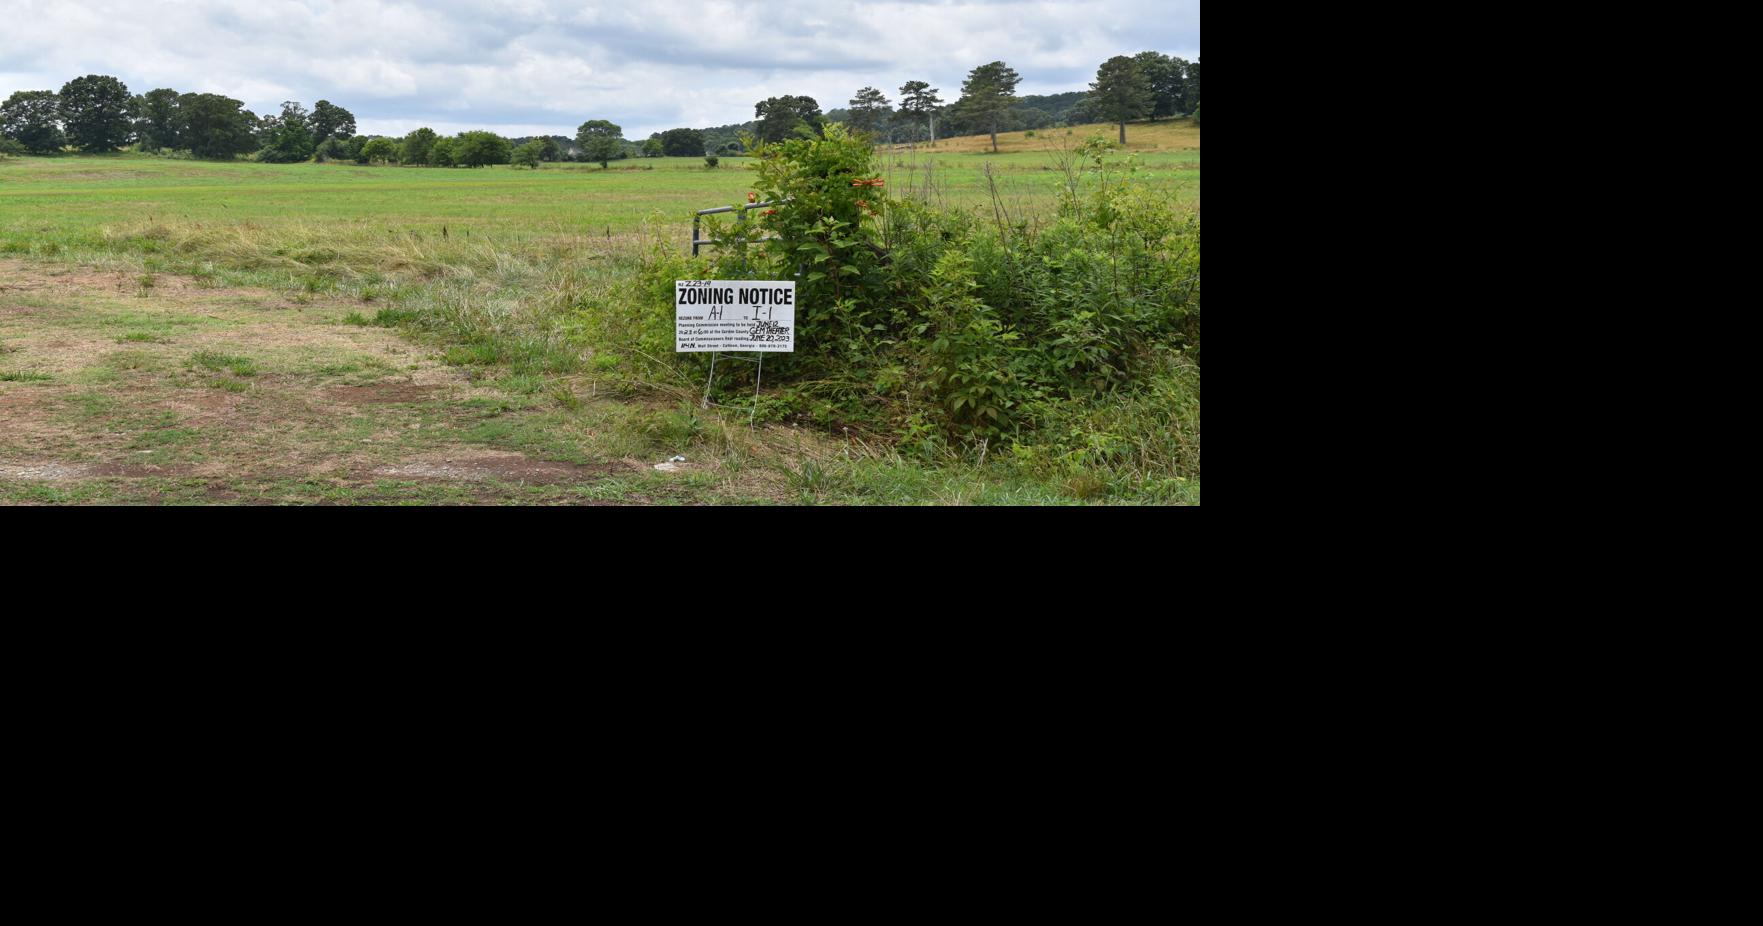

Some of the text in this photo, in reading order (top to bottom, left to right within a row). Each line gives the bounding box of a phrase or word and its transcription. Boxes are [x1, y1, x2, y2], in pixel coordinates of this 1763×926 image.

[678, 288, 792, 304] ZONING NOTICE
[708, 305, 723, 320] A-1
[752, 306, 772, 320] I-1
[750, 327, 765, 335] GEM
